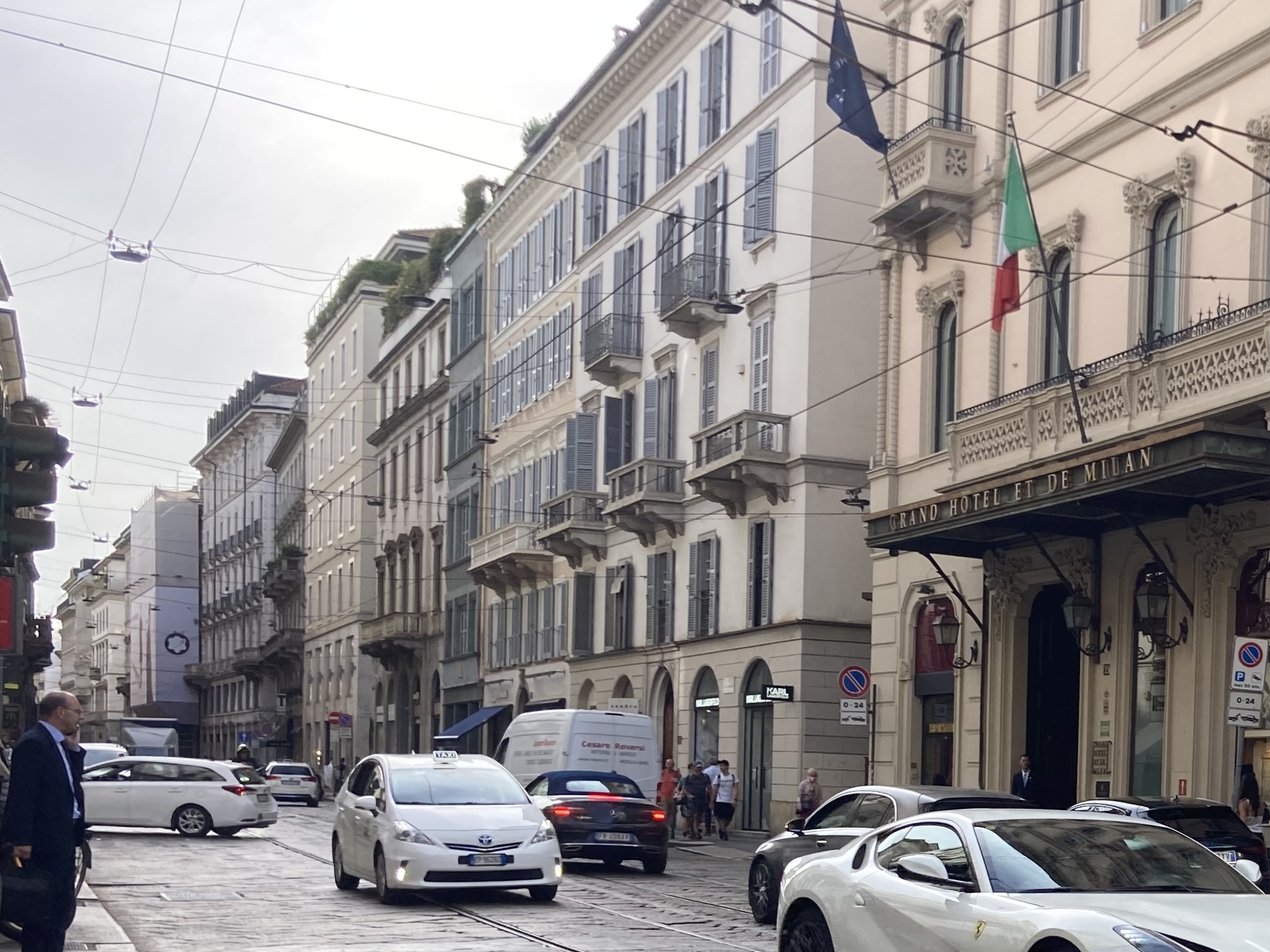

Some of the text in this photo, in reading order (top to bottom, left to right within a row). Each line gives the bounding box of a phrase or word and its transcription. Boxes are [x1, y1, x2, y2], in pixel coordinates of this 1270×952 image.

[889, 447, 1152, 532] GRAND HOTEL ET DE MILAN
[766, 687, 790, 696] KARL
[581, 740, 611, 749] Cesare
[435, 751, 457, 759] TAXI
